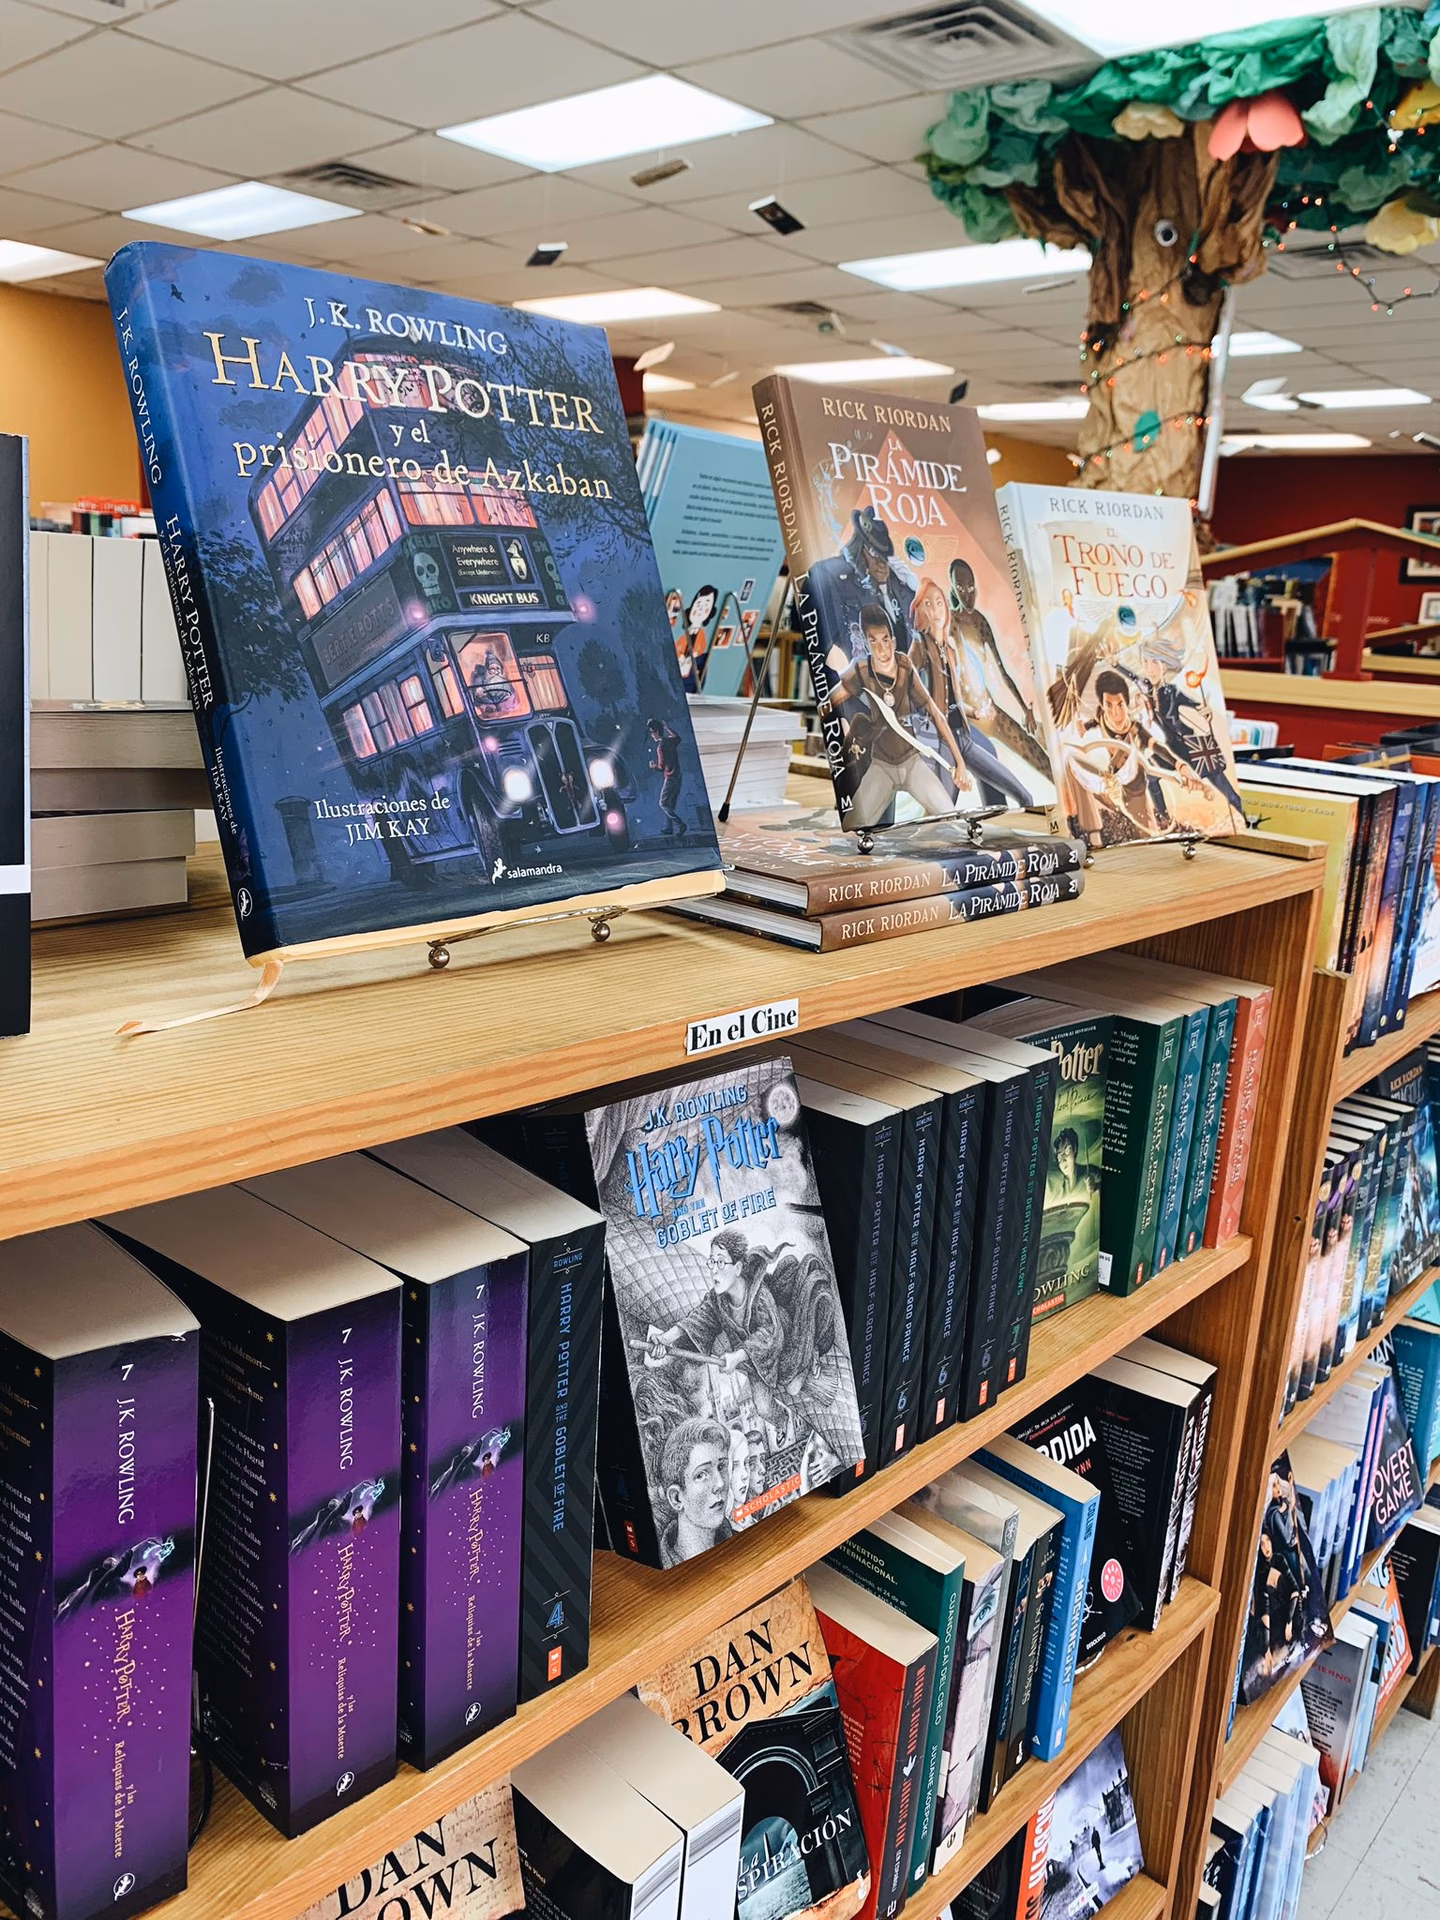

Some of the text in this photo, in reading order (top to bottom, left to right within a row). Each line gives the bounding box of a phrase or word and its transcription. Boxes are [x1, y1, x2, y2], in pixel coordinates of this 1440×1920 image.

[368, 307, 508, 355] ROWLING
[203, 332, 605, 435] HARRY POTTER
[127, 356, 163, 485] ROWLING
[389, 419, 430, 447] y el
[821, 397, 952, 433] RICK RIORDAN
[232, 436, 613, 500] prisionero de Azkaban
[827, 442, 967, 493] PIRÁMIDE
[887, 438, 903, 451] LA
[761, 403, 803, 556] RICK RIORDAN
[866, 483, 947, 527] ROJA
[1050, 498, 1164, 520] RICK RIORDAN
[452, 544, 489, 555] Anywhere
[1053, 535, 1175, 570] TRONO DE
[1106, 528, 1118, 539] EL
[456, 556, 499, 569] Everywhere
[1000, 504, 1014, 546] RICK
[1007, 551, 1030, 627] RIORDAN
[1071, 566, 1168, 600] FUEGO
[166, 513, 214, 710] HARRY POTTER
[469, 592, 541, 606] KNIGHT BUS
[164, 557, 201, 710] prisionero de Azkaban
[535, 633, 550, 644] KB
[794, 571, 846, 781] LA PIRÁMIDE ROJA
[210, 765, 229, 822] JIM KAY
[215, 746, 236, 820] Ilustraciones
[314, 791, 451, 820] Ilustraciones de
[345, 818, 431, 847] JIM KAY
[507, 863, 563, 879] salamandra
[828, 851, 1060, 903] RICK RIORDAN LA PIRÁMIDE ROJA
[841, 881, 1060, 940] RICK RIORDAN LA PIRÁMIDE ROJA
[689, 1008, 797, 1052] En el Cine
[675, 1085, 748, 1123] ROWLING
[1034, 1095, 1043, 1132] HARRY
[1004, 1111, 1013, 1148] HARRY
[625, 1115, 783, 1220] Harry Potter
[876, 1153, 886, 1195] HARRY
[1000, 1153, 1010, 1195] POTTER
[1029, 1136, 1039, 1178] POTTER
[656, 1187, 777, 1249] GOBLET OF FIRE
[672, 1198, 706, 1218] AND THE
[872, 1200, 883, 1247] POTTER
[943, 1120, 969, 1339] HARRY POTTER HALF-BLOOD PRINCE
[1022, 1196, 1033, 1244] DEATHLY
[553, 1252, 583, 1268] ROWLING
[902, 1138, 926, 1363] HARRY POTTER HALF-BLOOD PRINCE
[990, 1214, 1004, 1283] HALF-BLOOD
[475, 1284, 485, 1299] 7
[865, 1268, 880, 1342] HALF-BLOOD
[987, 1284, 998, 1323] PRINCE
[342, 1328, 352, 1344] 7
[121, 1363, 134, 1381] 7
[472, 1341, 485, 1419] ROWLING
[861, 1343, 873, 1387] PRINCE
[339, 1387, 353, 1470] ROWLING
[553, 1282, 573, 1533] HARRY POTTER GOBLET OF FIRE
[118, 1430, 135, 1524] ROWLING
[1373, 1437, 1416, 1499] OVERT
[743, 1476, 801, 1514] SCHOLASTIC
[1375, 1470, 1414, 1525] GAME
[469, 1488, 484, 1581] HARRY POTTER
[337, 1542, 355, 1643] HARRY POTTER
[546, 1601, 564, 1628] 4
[1062, 1502, 1096, 1686] COLLINS MOCKINGJAY
[115, 1608, 136, 1723] HARRY POTTER
[466, 1595, 476, 1690] Reliquias Muerte
[690, 1618, 775, 1700] DAN
[336, 1657, 347, 1760] Reliquias de la Muerte
[920, 1592, 957, 1840] CUANDO CAI DEL CIELO JULIANE KOEPCKE
[112, 1740, 125, 1858] Reliquias de la Muerte
[127, 1790, 136, 1804] las
[335, 1815, 447, 1920] DAN
[738, 1851, 760, 1878] La
